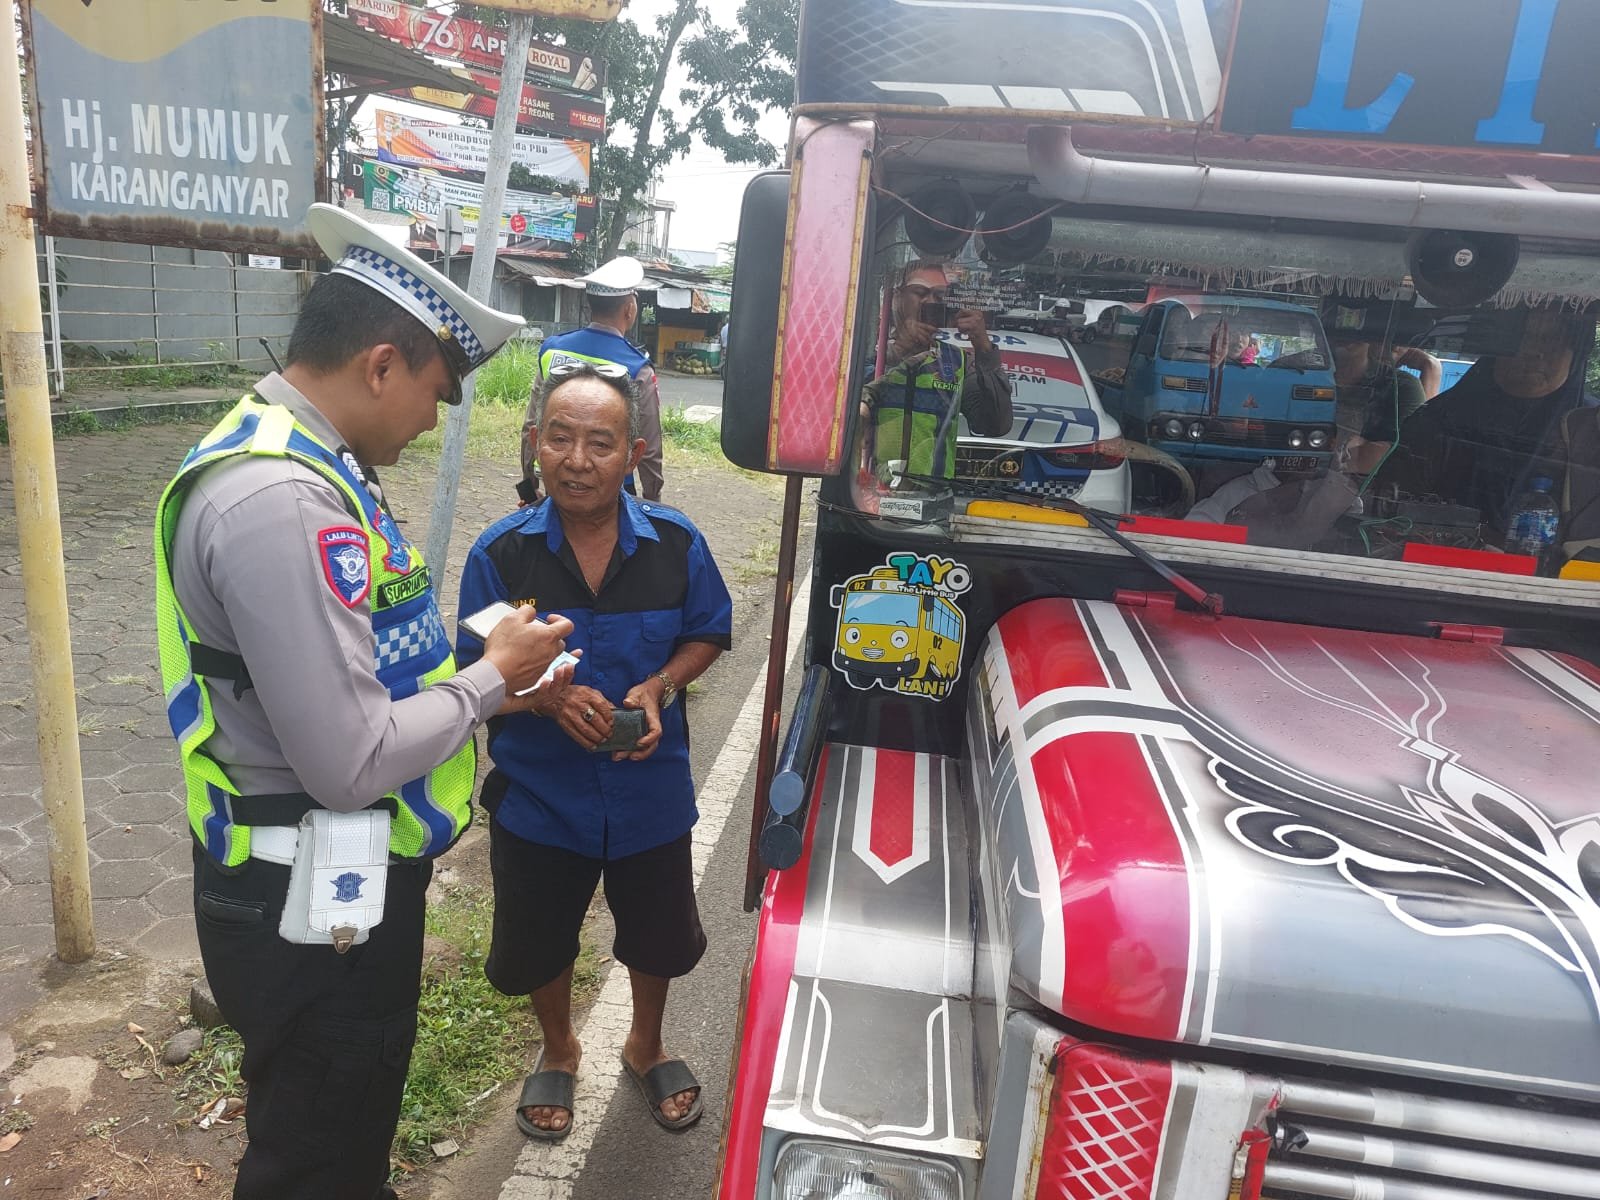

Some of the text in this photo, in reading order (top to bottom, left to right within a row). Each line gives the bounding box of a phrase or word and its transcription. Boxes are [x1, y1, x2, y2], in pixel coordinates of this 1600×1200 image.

[418, 15, 454, 50] 76
[532, 50, 567, 69] ROYAL
[523, 97, 550, 110] RASANE
[528, 108, 555, 120] REGANE
[62, 98, 292, 165] Hj. MUMUK
[70, 161, 289, 218] KARANGANYAR
[394, 195, 440, 214] PMBM
[888, 556, 970, 592] TAYO
[932, 635, 943, 650] 02
